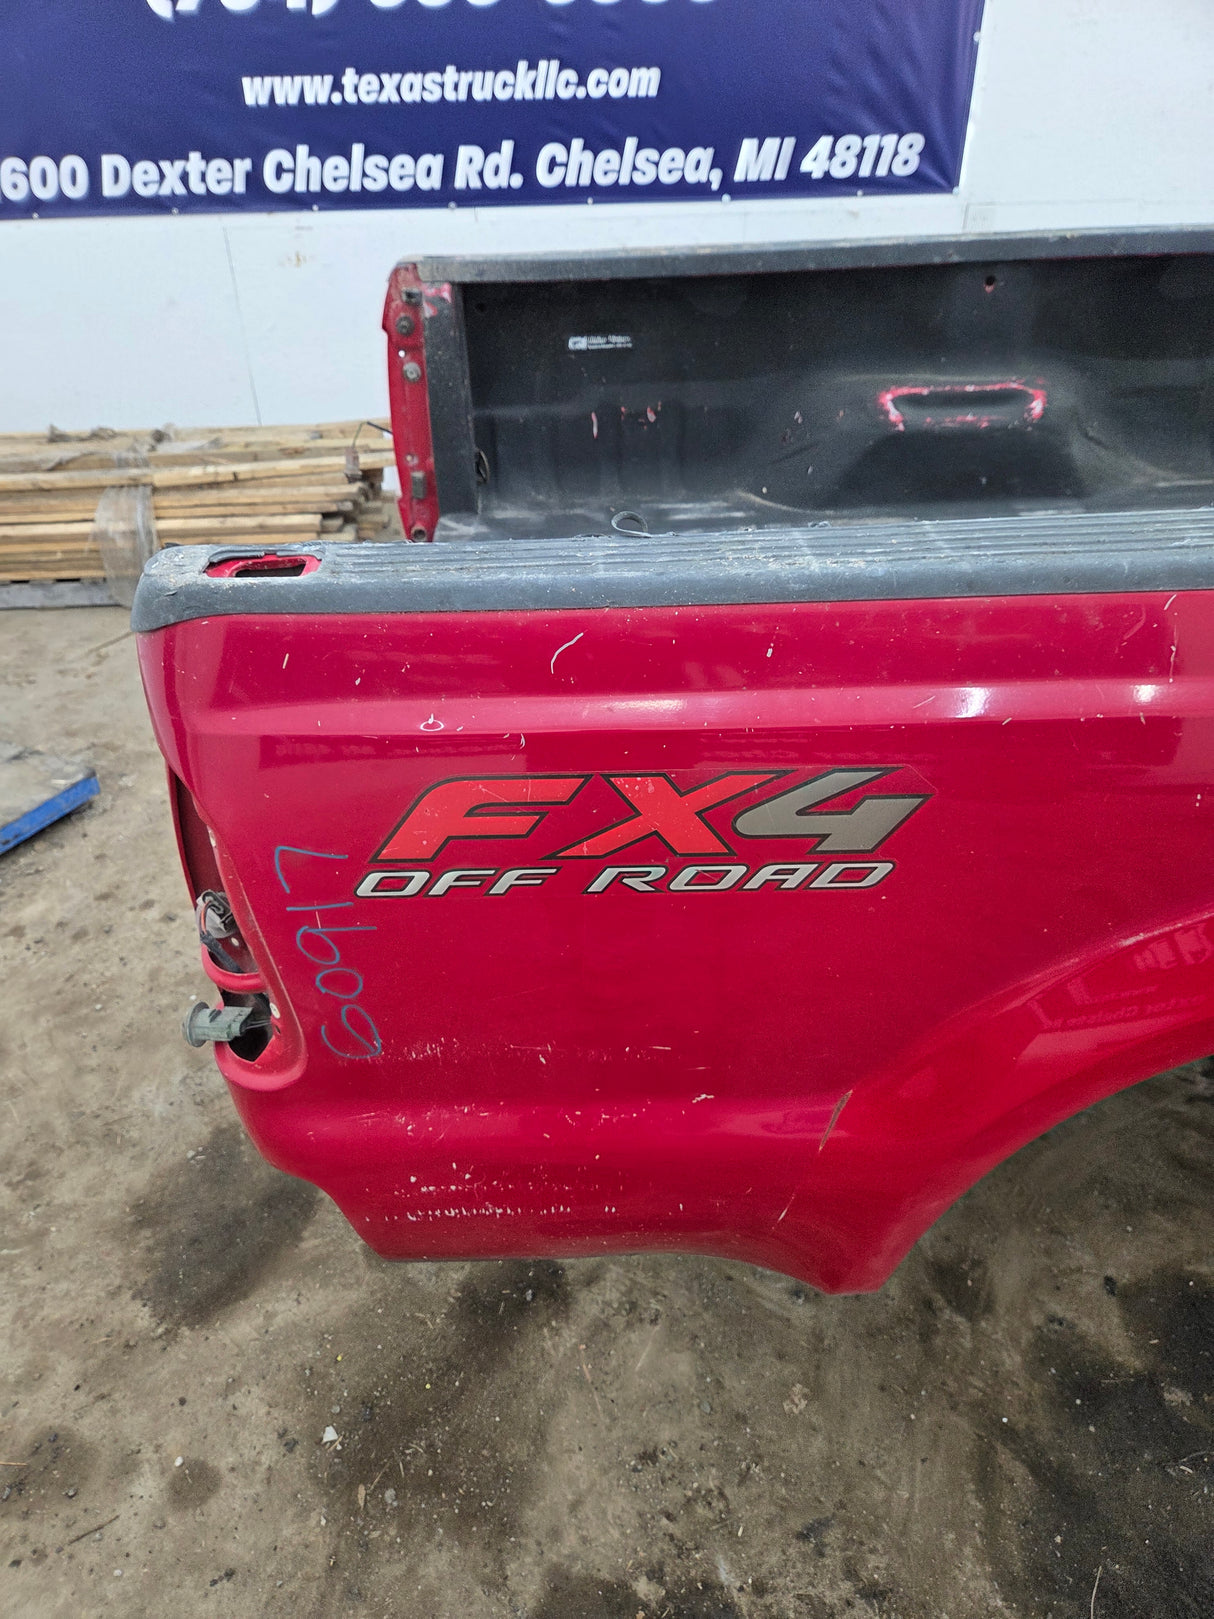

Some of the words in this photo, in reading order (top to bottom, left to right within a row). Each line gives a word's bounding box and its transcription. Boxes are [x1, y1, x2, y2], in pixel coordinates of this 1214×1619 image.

[241, 59, 661, 107] www.texastruckllc.com
[0, 153, 90, 203] 600
[101, 151, 252, 198] Dexter
[262, 143, 445, 194] Chelsea
[453, 139, 524, 190] Rd.
[535, 136, 724, 190] Chelsea,
[733, 136, 797, 182] MI
[800, 132, 926, 180] 48118
[369, 767, 933, 863] FX4
[354, 866, 563, 899] OFF
[582, 861, 896, 895] ROAD
